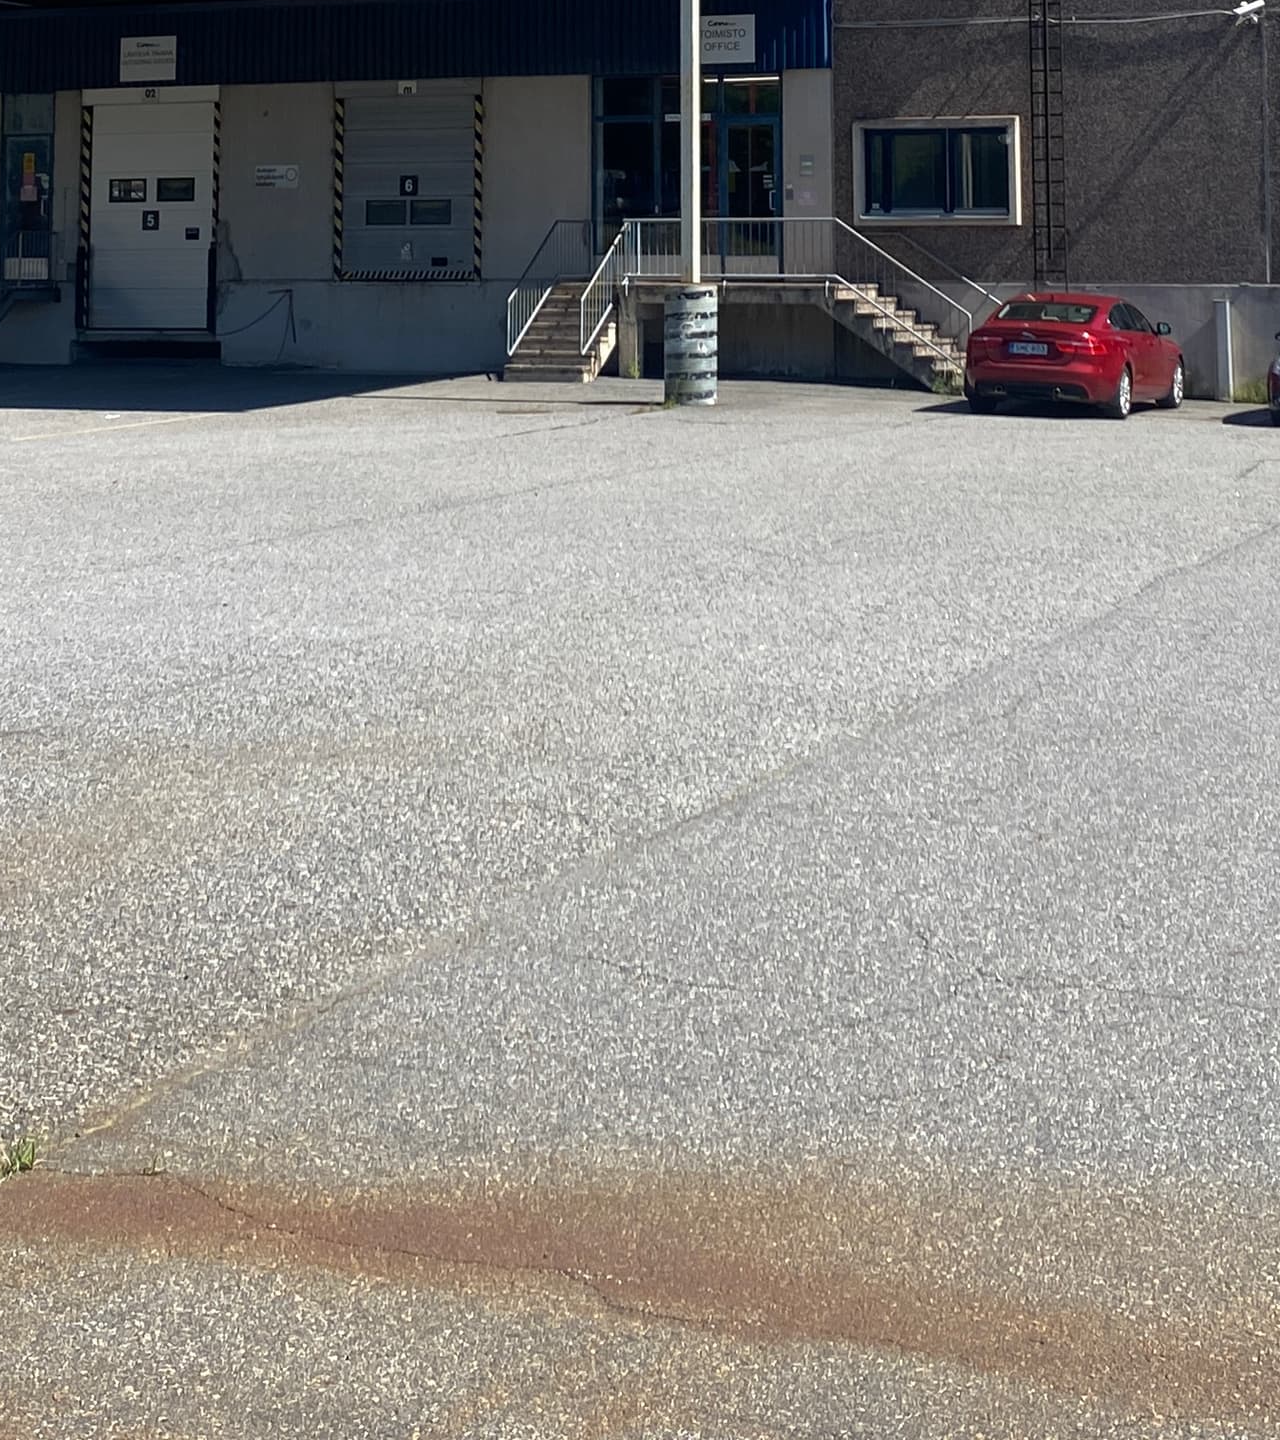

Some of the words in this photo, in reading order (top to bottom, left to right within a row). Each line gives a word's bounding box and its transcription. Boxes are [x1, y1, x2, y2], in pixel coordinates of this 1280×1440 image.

[704, 41, 741, 51] OFFICE
[405, 179, 413, 192] 6
[146, 214, 155, 227] 5
